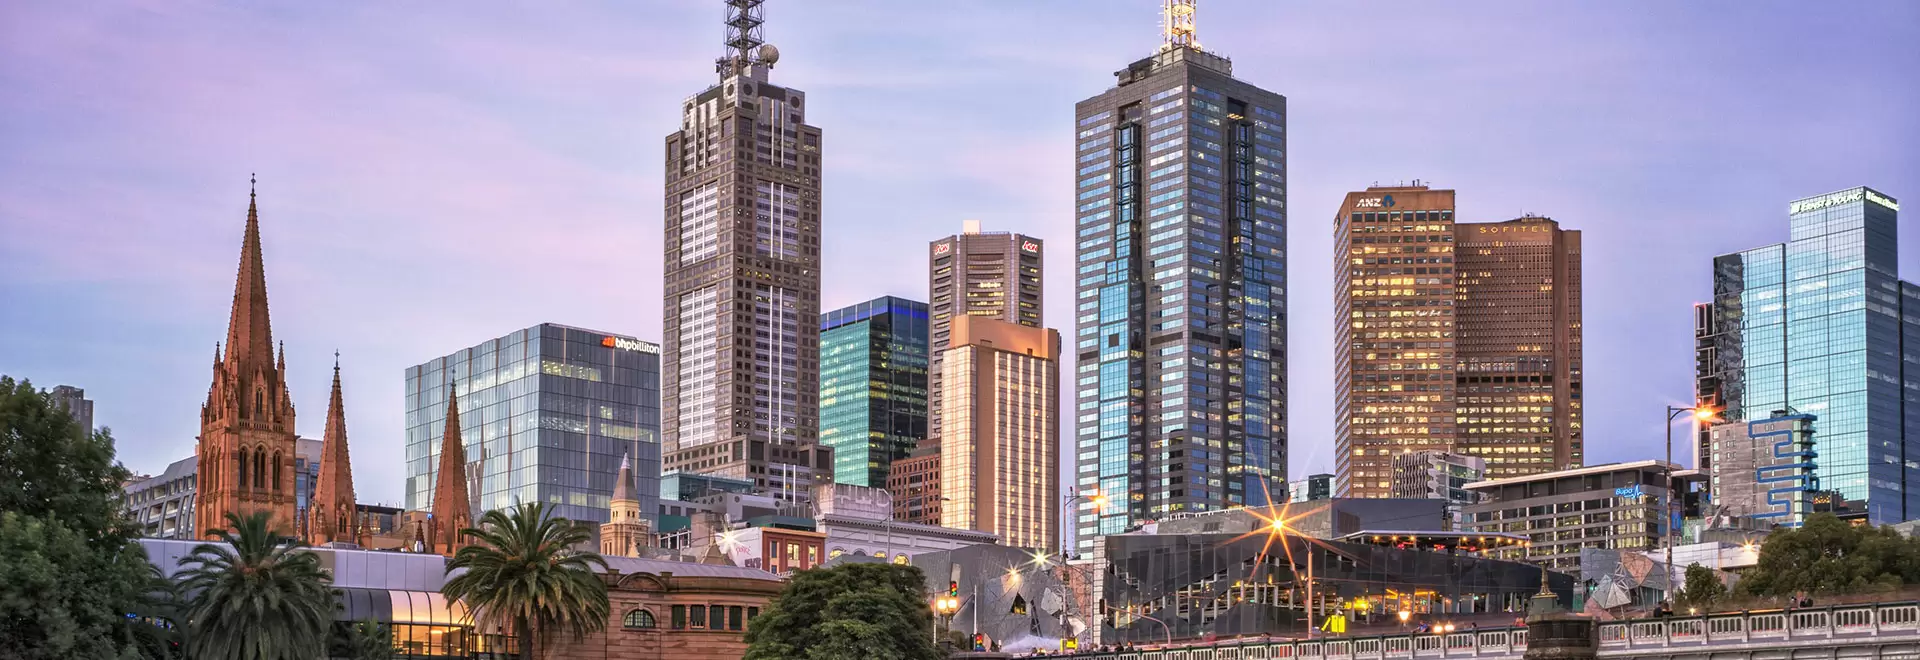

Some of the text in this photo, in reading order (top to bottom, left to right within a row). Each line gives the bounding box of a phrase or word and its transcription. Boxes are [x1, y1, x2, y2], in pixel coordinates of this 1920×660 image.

[1356, 198, 1382, 208] ANZ
[1479, 225, 1549, 234] SOFITEL
[615, 337, 660, 354] bhpbilliton
[1615, 487, 1633, 497] Bupa
